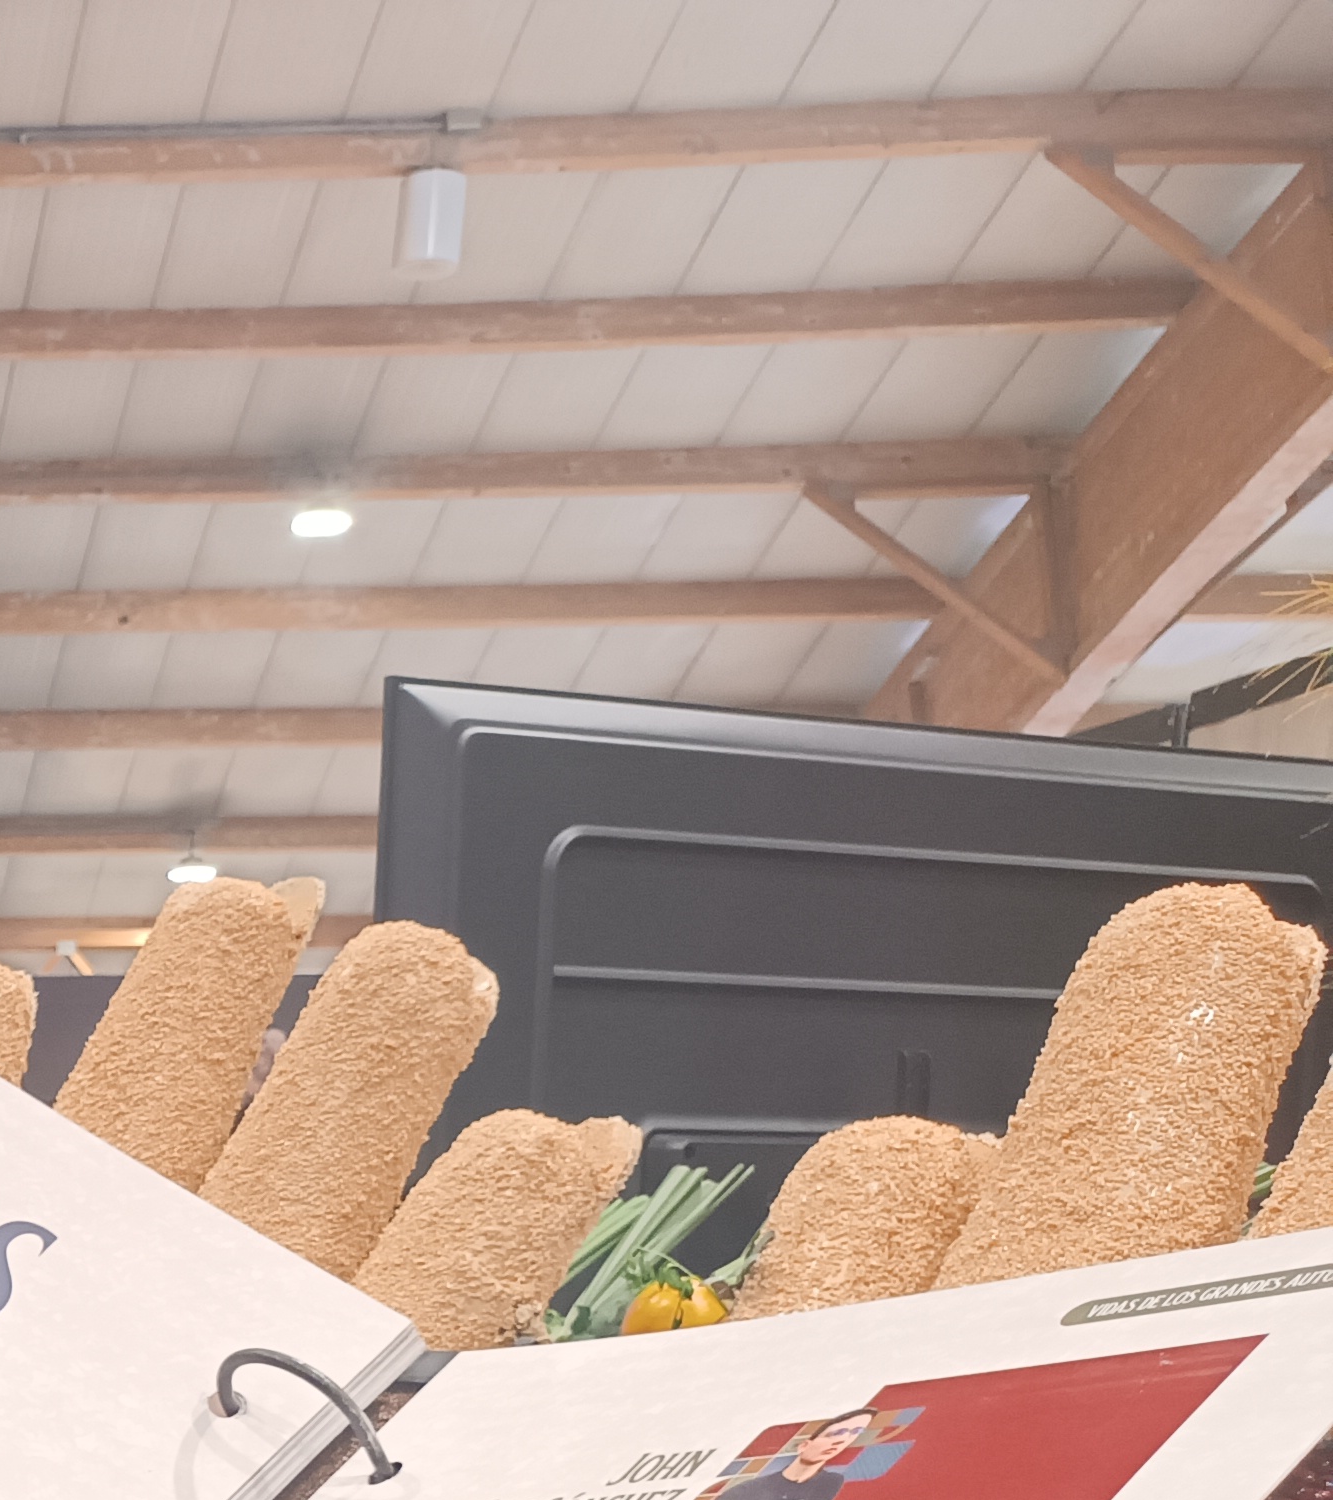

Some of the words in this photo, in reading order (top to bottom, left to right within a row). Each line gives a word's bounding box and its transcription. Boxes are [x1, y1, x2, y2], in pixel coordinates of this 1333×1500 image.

[1087, 1301, 1136, 1318] VIDAS
[1136, 1294, 1163, 1311] DE
[1165, 1289, 1200, 1307] LOS
[1200, 1276, 1289, 1301] GRANDES
[605, 1448, 717, 1486] JOHN
